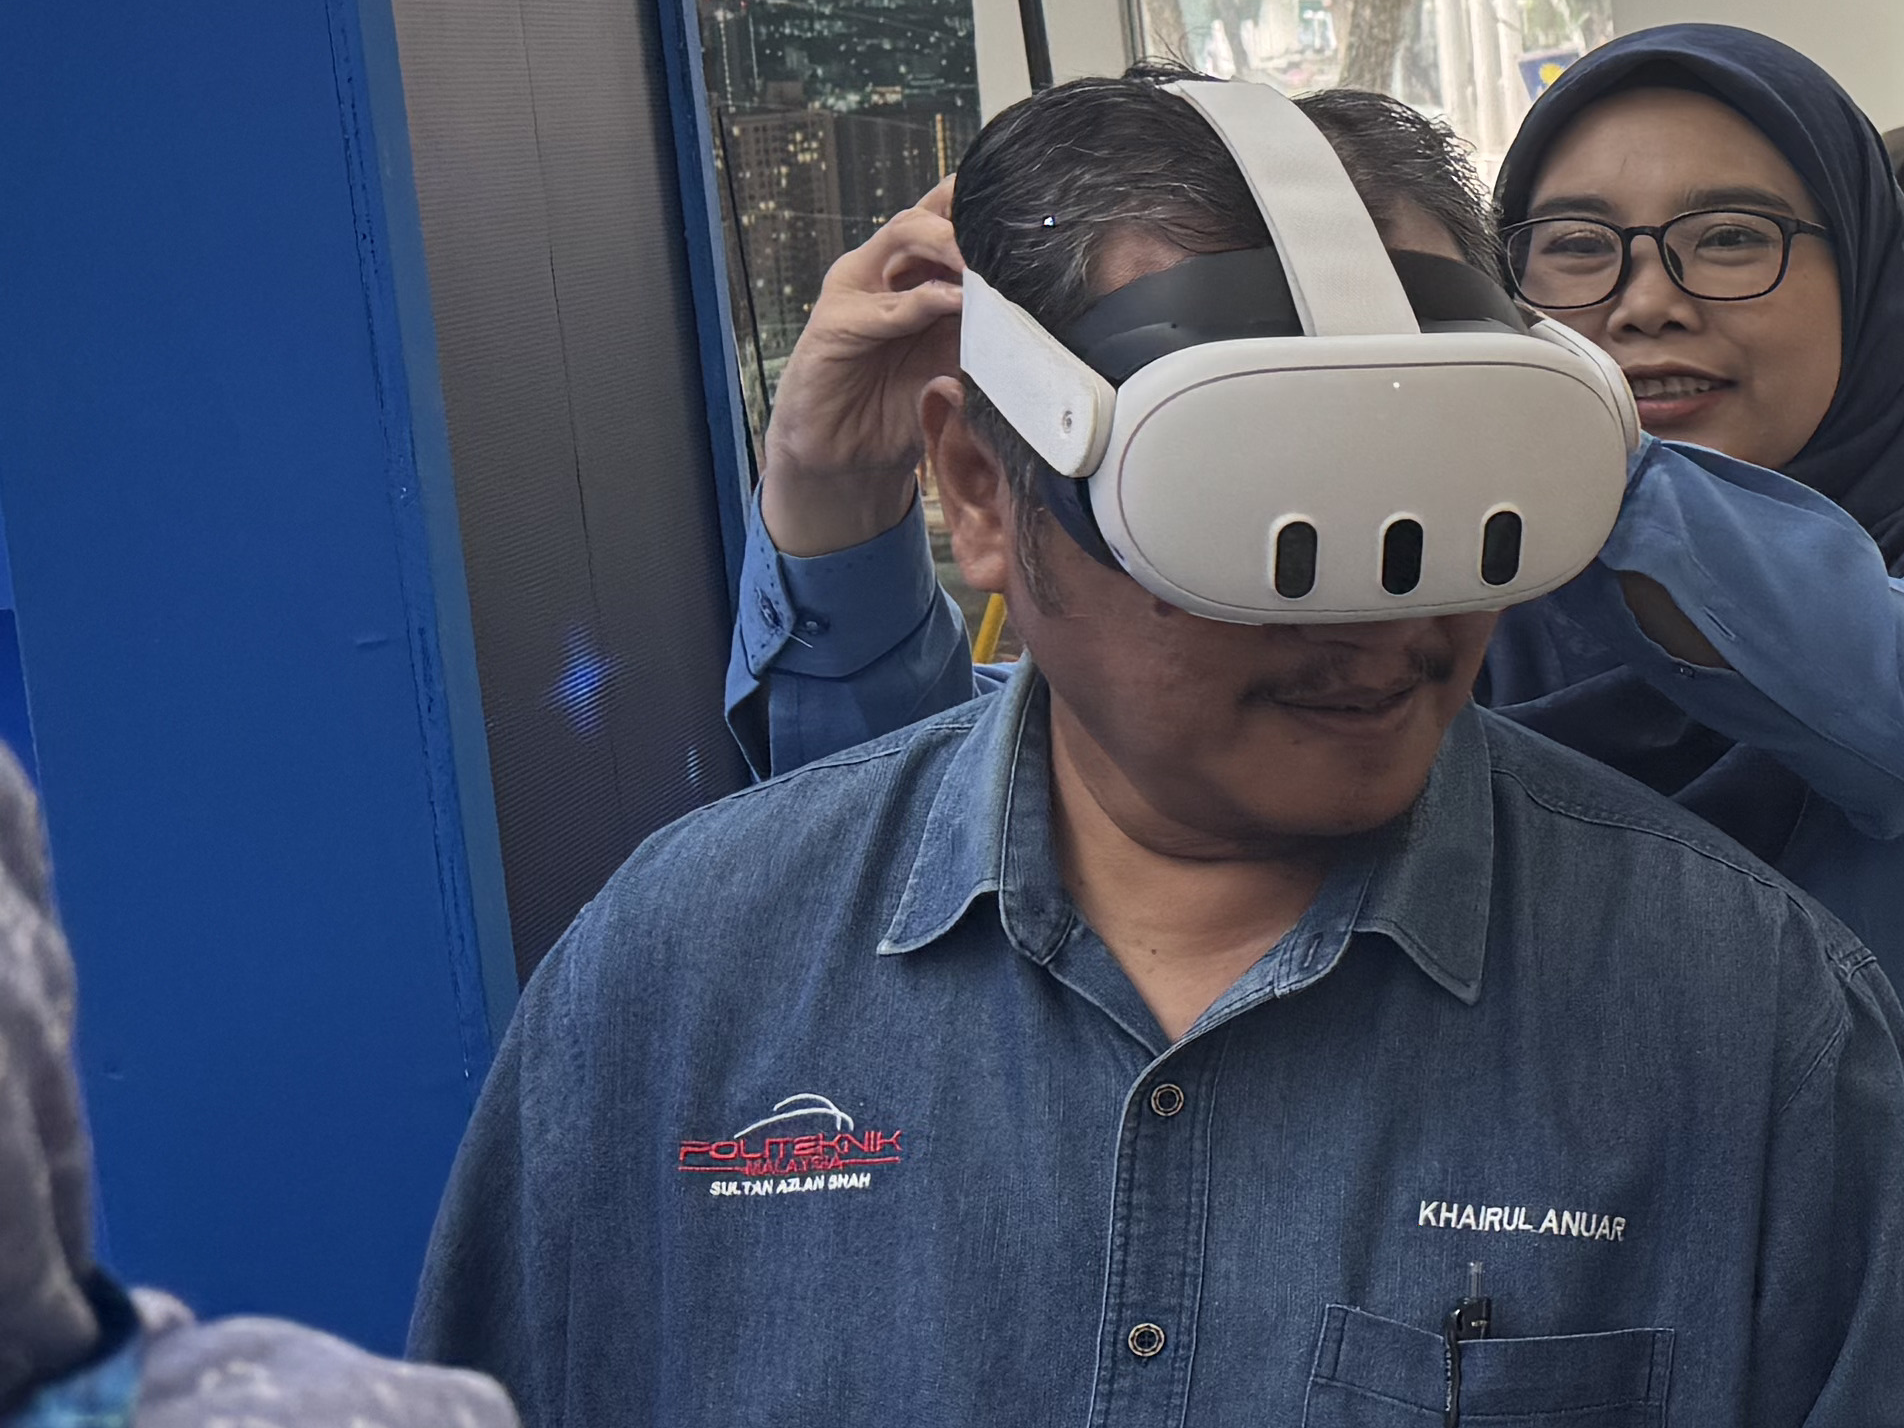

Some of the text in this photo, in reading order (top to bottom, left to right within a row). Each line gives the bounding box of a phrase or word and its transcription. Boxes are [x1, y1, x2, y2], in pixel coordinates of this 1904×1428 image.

[679, 1129, 903, 1162] POLITEKNIK
[745, 1154, 843, 1177] MALAYSIA
[709, 1178, 773, 1197] SULTAN
[776, 1174, 824, 1194] AZLAN
[1418, 1200, 1626, 1242] KHAIRUL ANUAR
